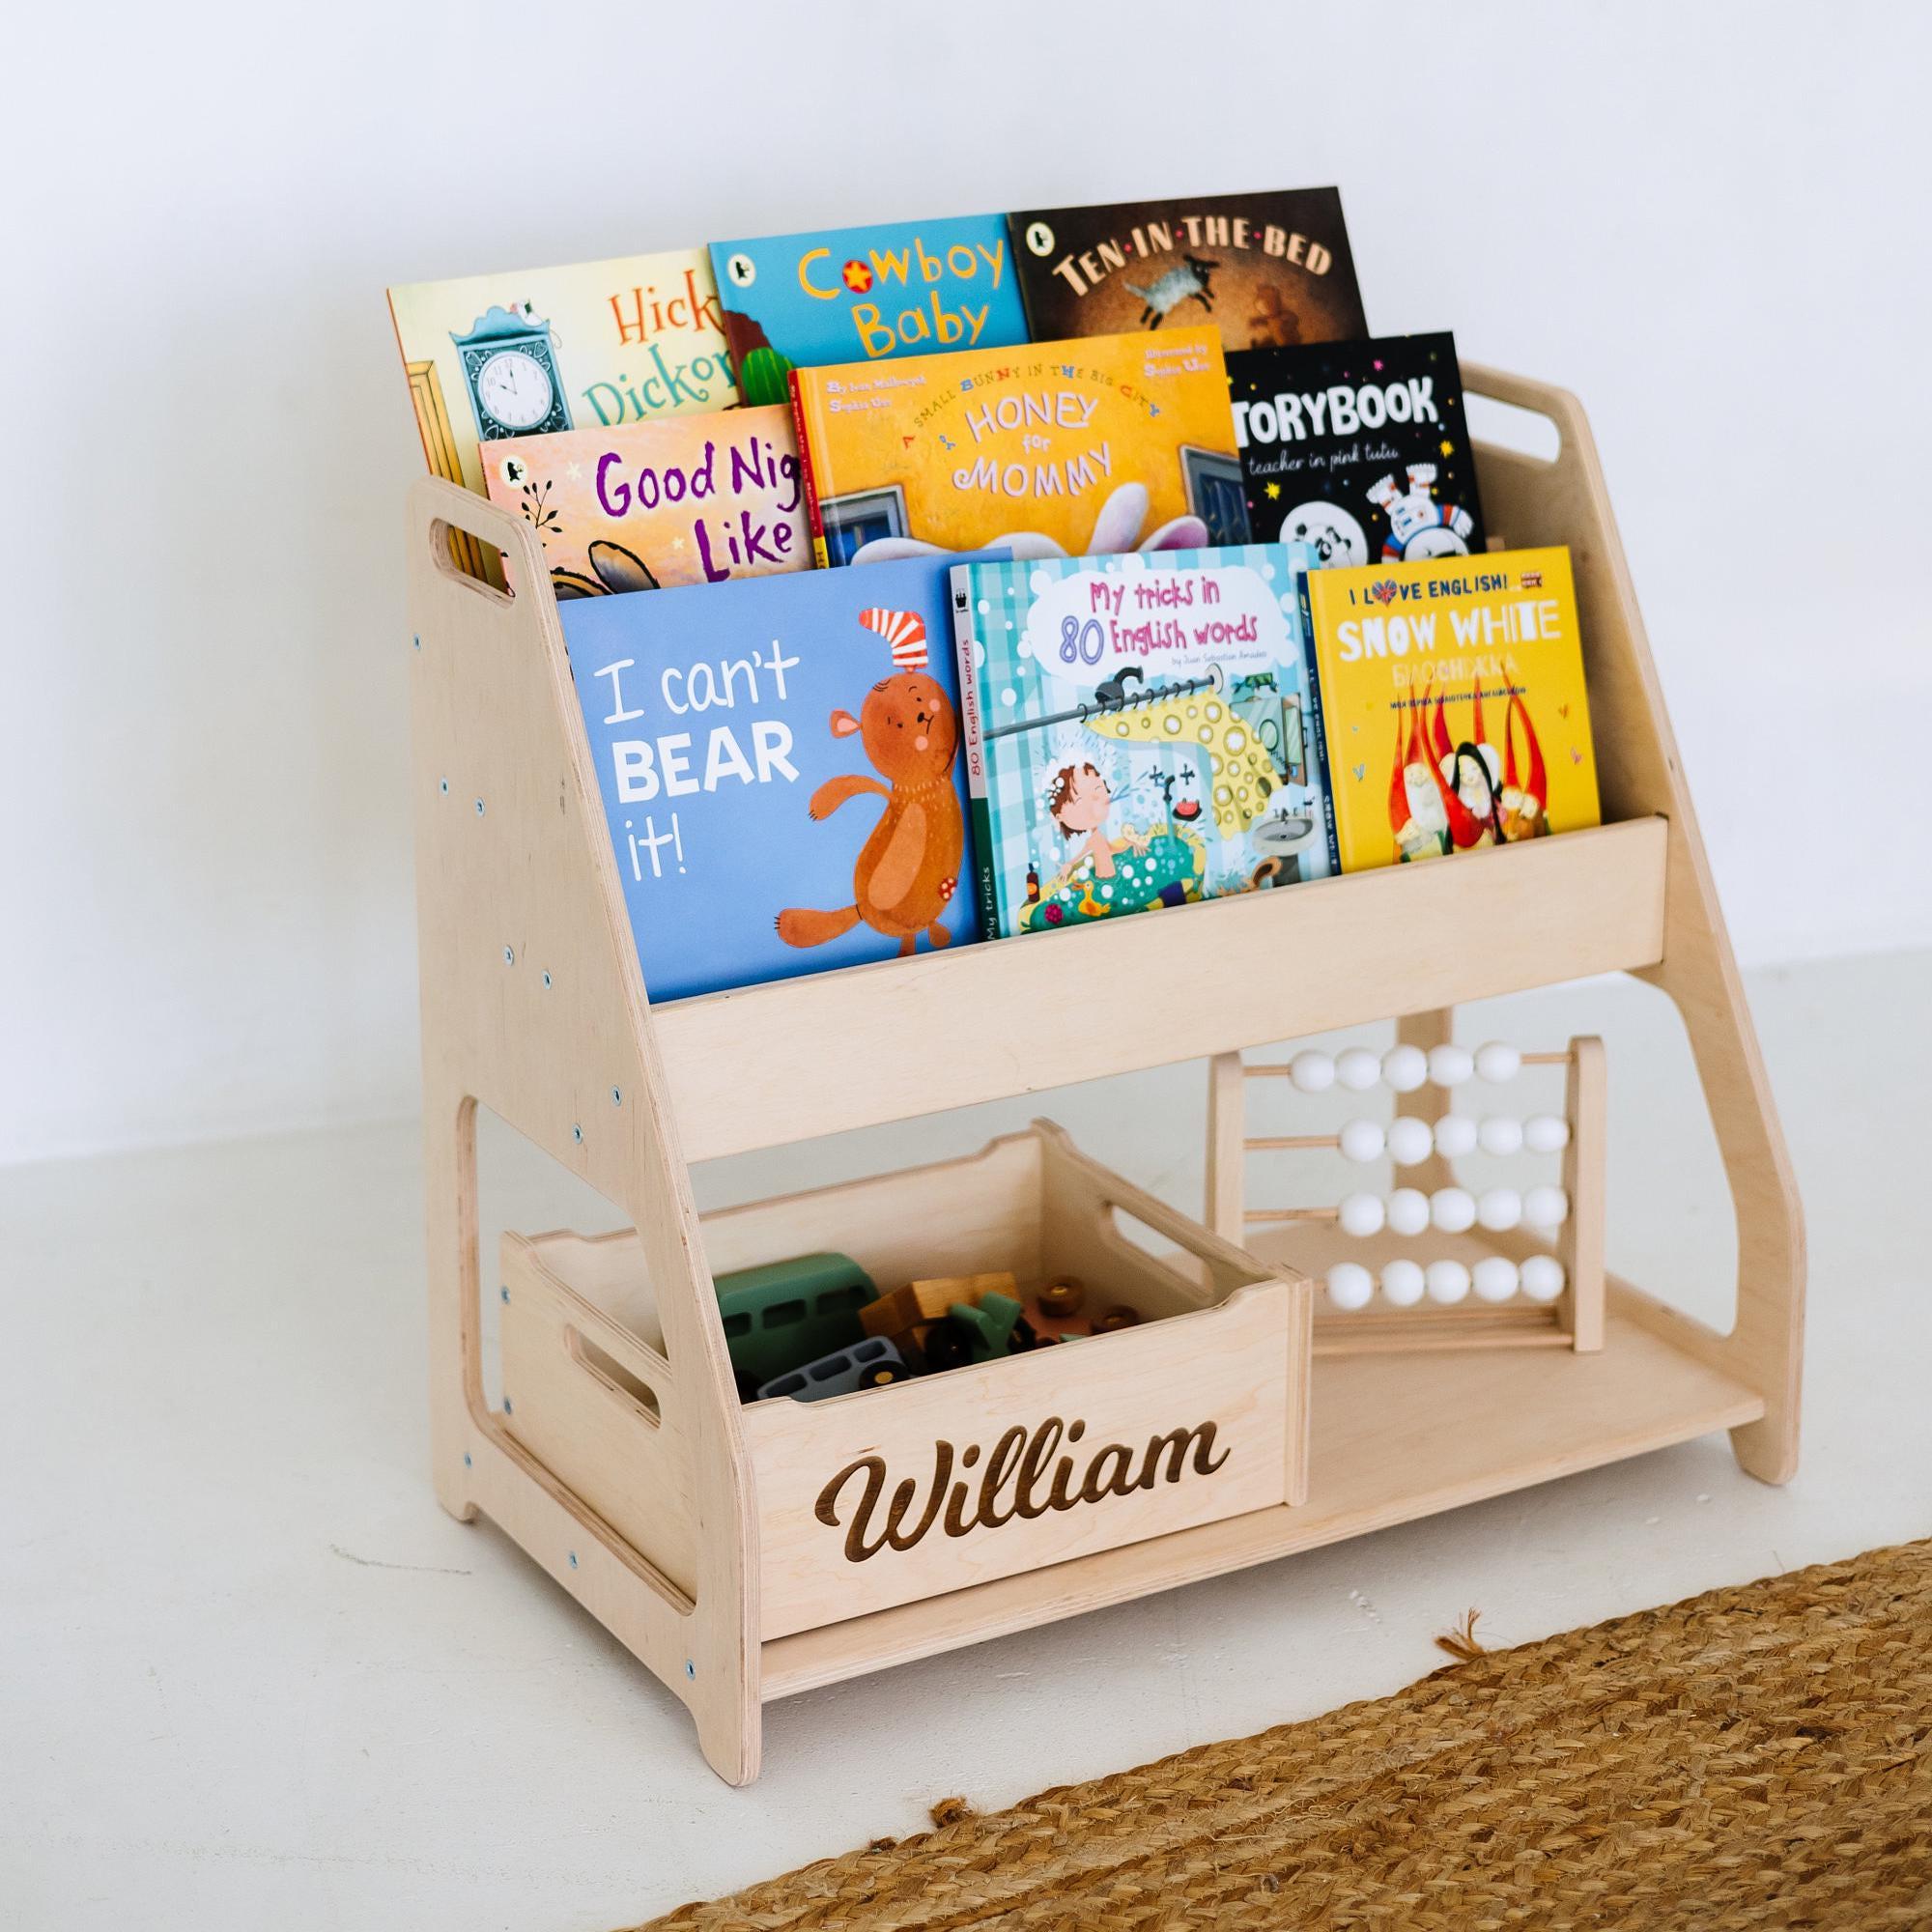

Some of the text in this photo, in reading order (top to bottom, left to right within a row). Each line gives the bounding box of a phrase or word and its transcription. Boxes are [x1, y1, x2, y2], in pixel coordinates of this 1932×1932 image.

[1052, 215, 1332, 297] TEN IN THE BED
[608, 269, 726, 346] Hick
[851, 290, 989, 358] Baby
[914, 389, 956, 427] SMALL
[959, 364, 1020, 392] BUNNY
[1028, 363, 1043, 378] IN
[1050, 364, 1084, 379] THE
[1090, 370, 1114, 386] BIG
[1120, 384, 1160, 417] CITY
[965, 391, 1099, 443] HONEY
[952, 440, 1113, 498] MOMMY
[1021, 434, 1051, 455] for
[1247, 442, 1400, 476] teacher in pink tutu
[596, 440, 716, 518] Good
[694, 510, 792, 582] Like
[1090, 575, 1220, 616] My tricks in
[1349, 588, 1356, 606] I
[1429, 573, 1509, 598] ENGLISH!
[1059, 615, 1104, 666] 80
[1109, 618, 1188, 657] English
[1193, 612, 1258, 645] words
[1337, 611, 1437, 663] SNOW
[1449, 599, 1562, 648] WHITE
[593, 659, 644, 724] I
[961, 639, 981, 776] 80 English words
[611, 719, 800, 804] BEAR
[624, 811, 687, 882] it!
[981, 867, 998, 940] My tricks
[814, 1416, 1232, 1563] William
